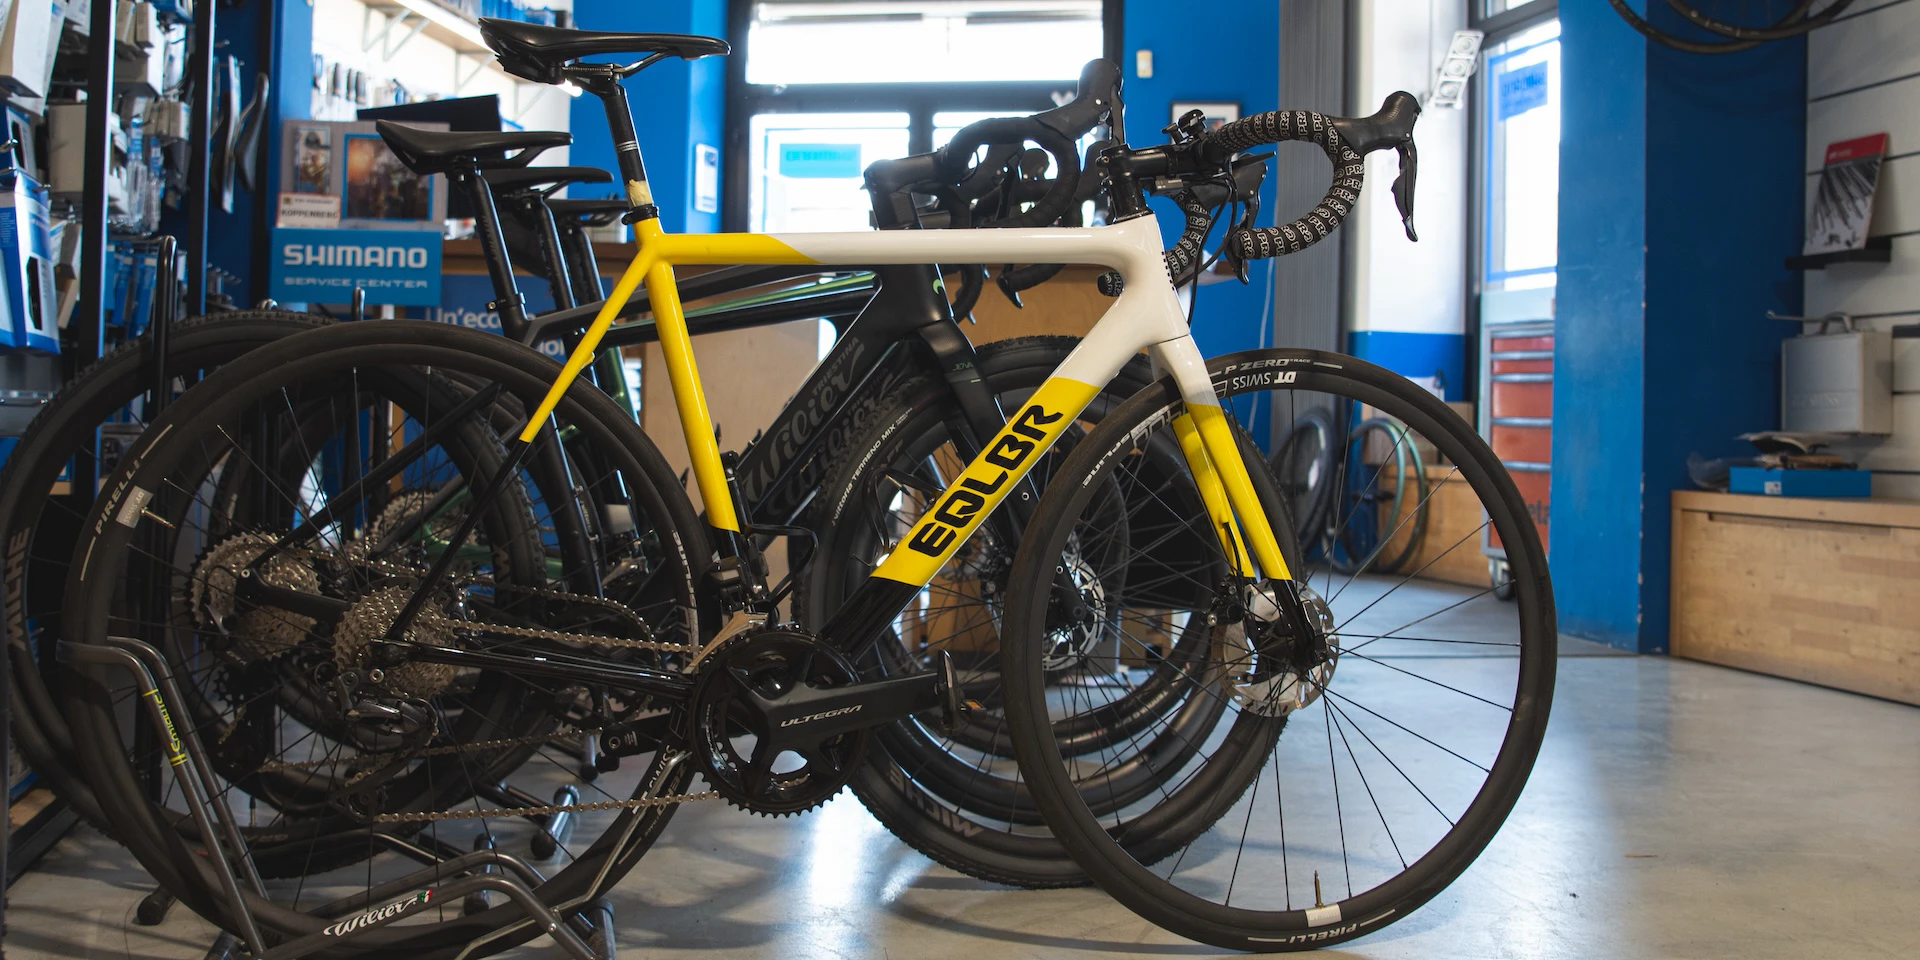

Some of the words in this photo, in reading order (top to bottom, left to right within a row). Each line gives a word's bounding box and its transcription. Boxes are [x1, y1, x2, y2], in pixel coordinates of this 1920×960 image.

[282, 243, 428, 269] SHIMANO
[284, 276, 352, 288] SERVICE
[355, 278, 428, 289] CENTER
[811, 336, 860, 397] TRIESTINA
[1224, 365, 1237, 375] P
[1239, 358, 1289, 372] ZERO
[1273, 371, 1297, 385] DT
[1232, 372, 1272, 391] SWISS
[743, 342, 866, 504] Wilier
[881, 423, 897, 441] MIX
[907, 404, 1065, 559] EQLBR
[94, 458, 141, 536] PIRELLI
[780, 704, 863, 728] ULTEGRA
[322, 895, 418, 937] Wilier
[1288, 922, 1358, 944] PIRELLI
